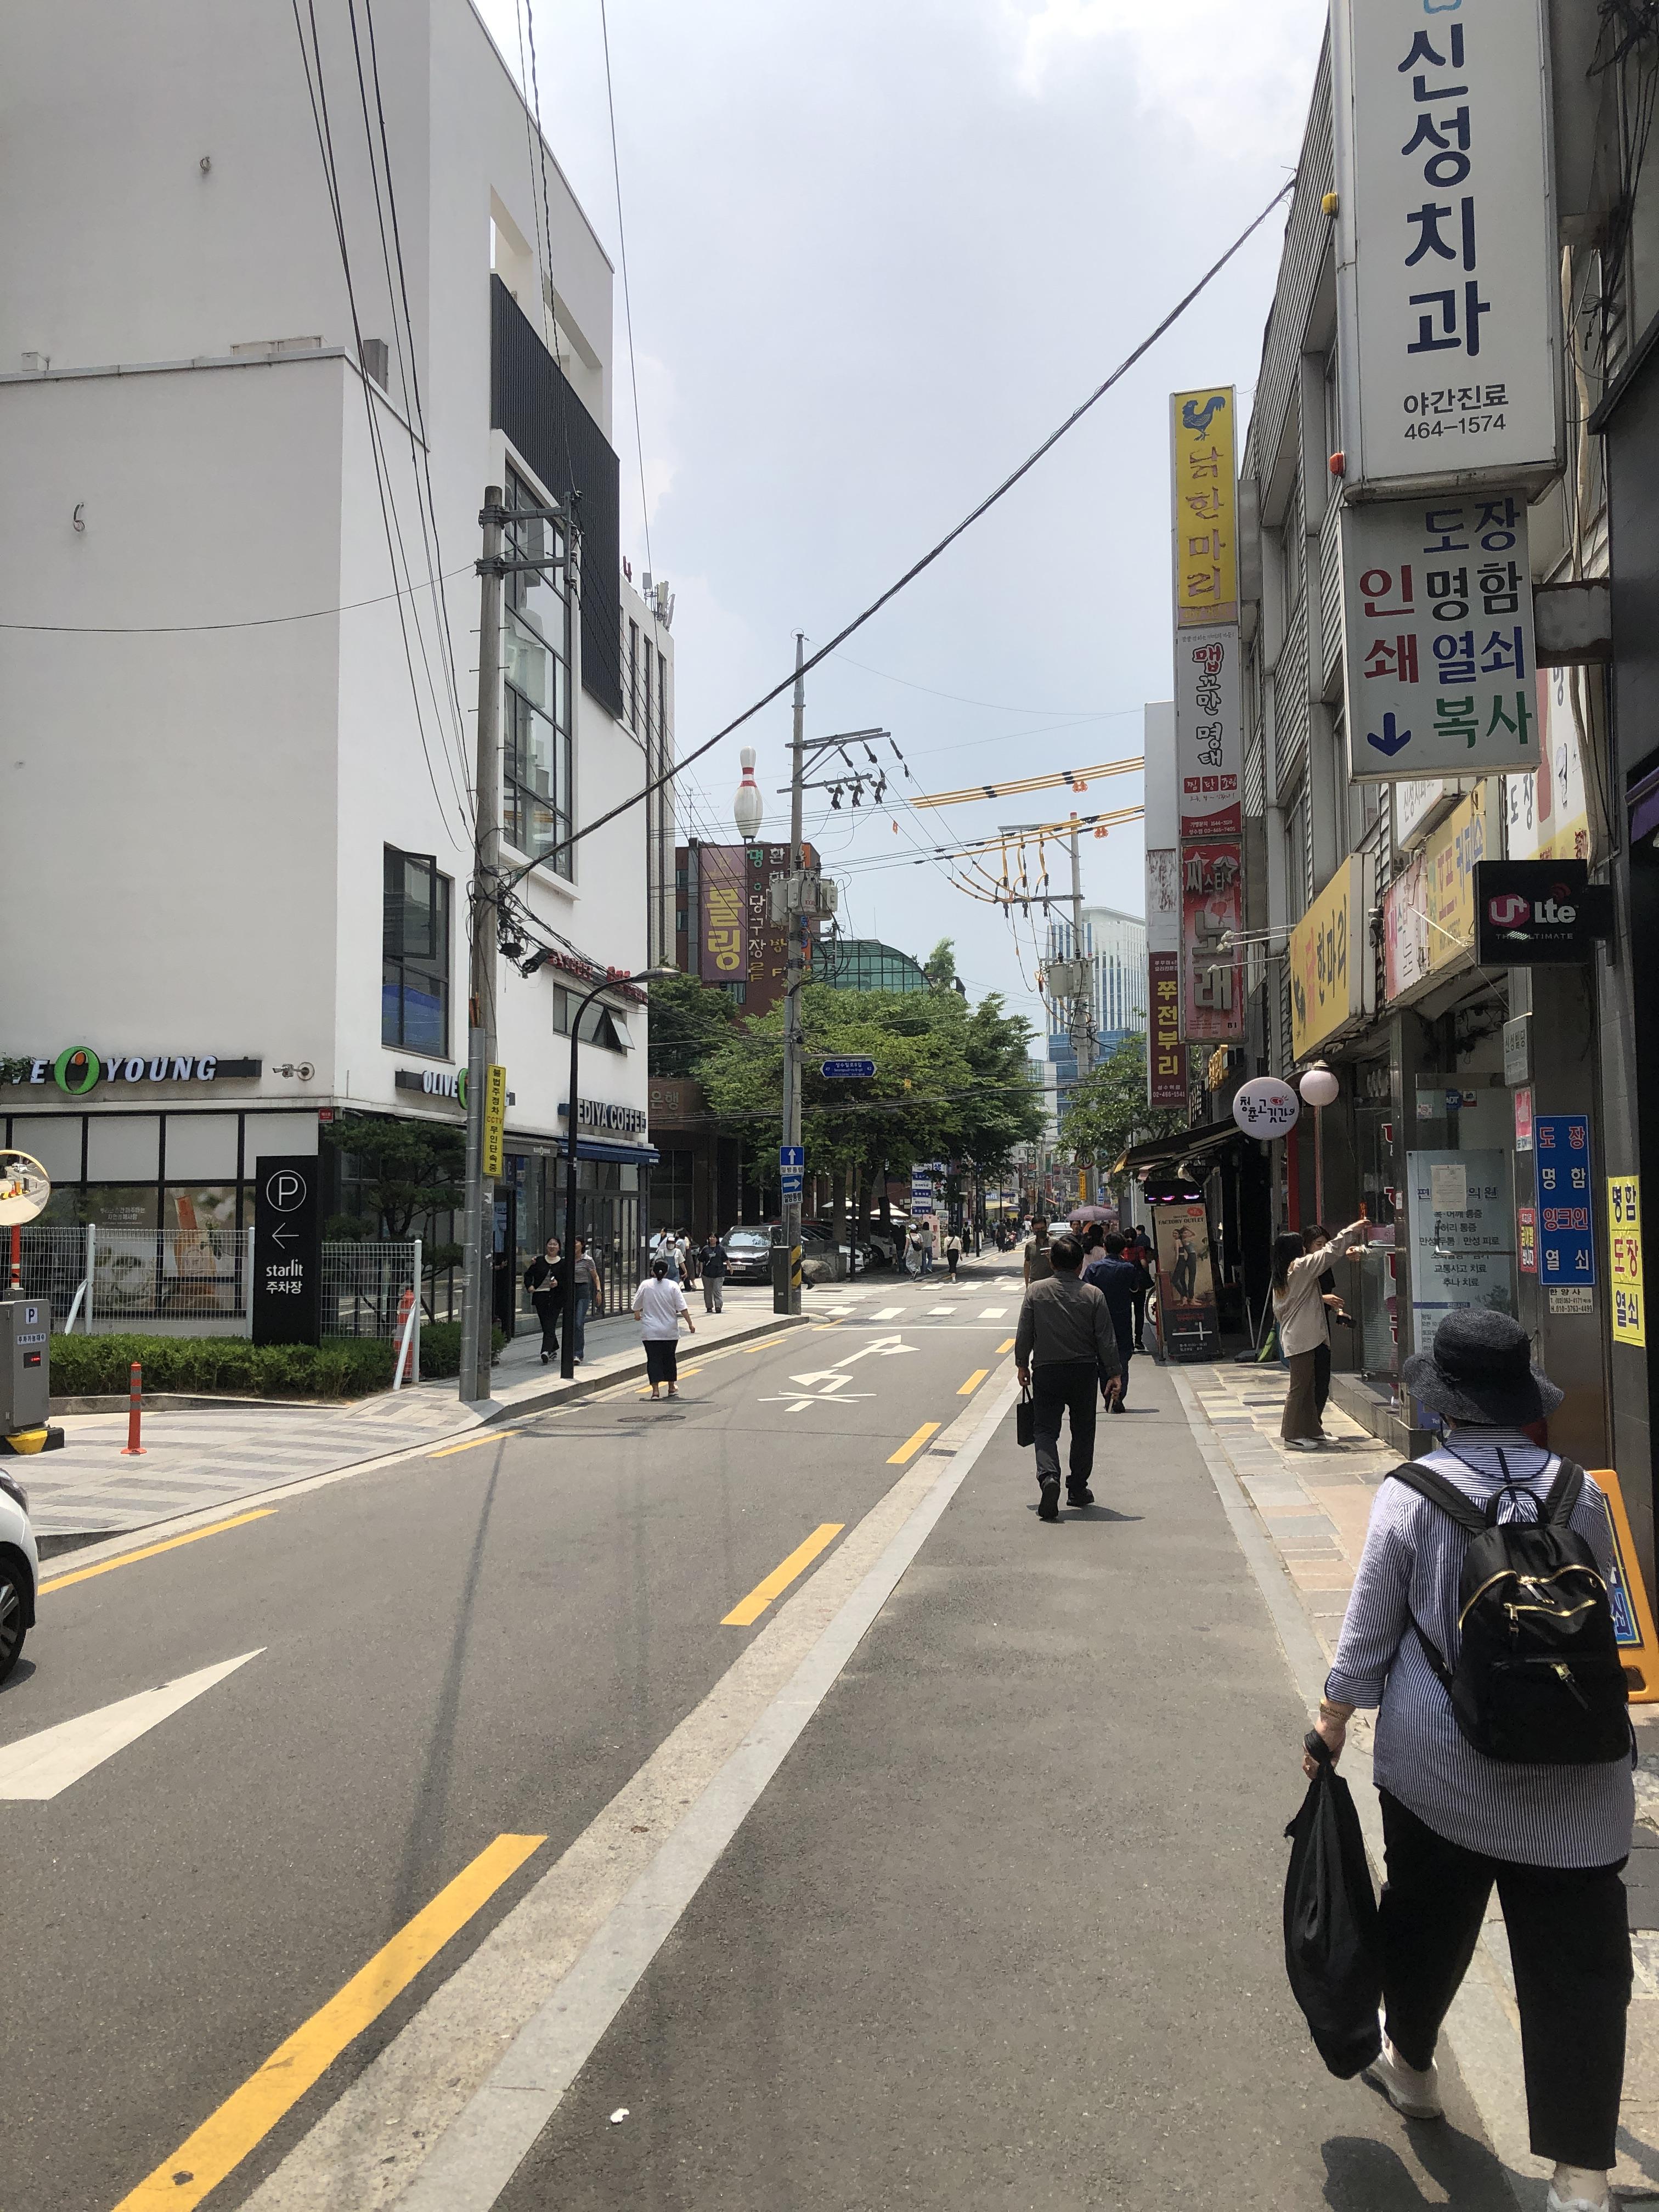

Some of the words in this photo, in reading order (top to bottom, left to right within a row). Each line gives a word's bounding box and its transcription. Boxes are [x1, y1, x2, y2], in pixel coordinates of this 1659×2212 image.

[1398, 23, 1491, 357] 신성치과
[1403, 383, 1509, 416] 야간진료
[1404, 413, 1506, 440] 464-1574
[1423, 497, 1521, 554] 도장
[1426, 561, 1523, 622] 명함
[1359, 564, 1419, 684] 인쇄
[1432, 625, 1526, 685] 열쇠
[1432, 691, 1533, 749] 복사
[1196, 721, 1223, 767] 명태
[705, 886, 744, 970] 볼링
[1192, 911, 1234, 1009] 노래
[1157, 981, 1179, 1076] 쭈전부리
[106, 1055, 218, 1083] YOUNG
[422, 1070, 458, 1098] OLIVE
[492, 1069, 501, 1115] 불법주정차
[650, 1089, 680, 1110] 은행
[486, 1116, 503, 1124] CCTV
[577, 1098, 607, 1128] EDIYA
[610, 1104, 646, 1133] COFFEE
[489, 1126, 499, 1172] 무인단속중
[279, 1177, 298, 1206] P
[1417, 1186, 1498, 1200] 편의원
[1612, 1184, 1636, 1223] 명함
[1440, 1223, 1457, 1232] 허리
[1459, 1223, 1477, 1232] 통증
[1465, 1209, 1483, 1218] 통증
[1543, 1207, 1589, 1231] 잉크인
[1463, 1237, 1481, 1246] 만성
[1614, 1238, 1639, 1277] 도장
[266, 1259, 303, 1277] starlit
[1434, 1264, 1468, 1273] 교통사고
[1470, 1264, 1488, 1273] 치료
[1443, 1277, 1460, 1286] 추나
[1462, 1277, 1480, 1286] 치료
[266, 1280, 303, 1294] 주차장
[29, 1308, 35, 1323] P
[1615, 1289, 1639, 1330] 열쇠
